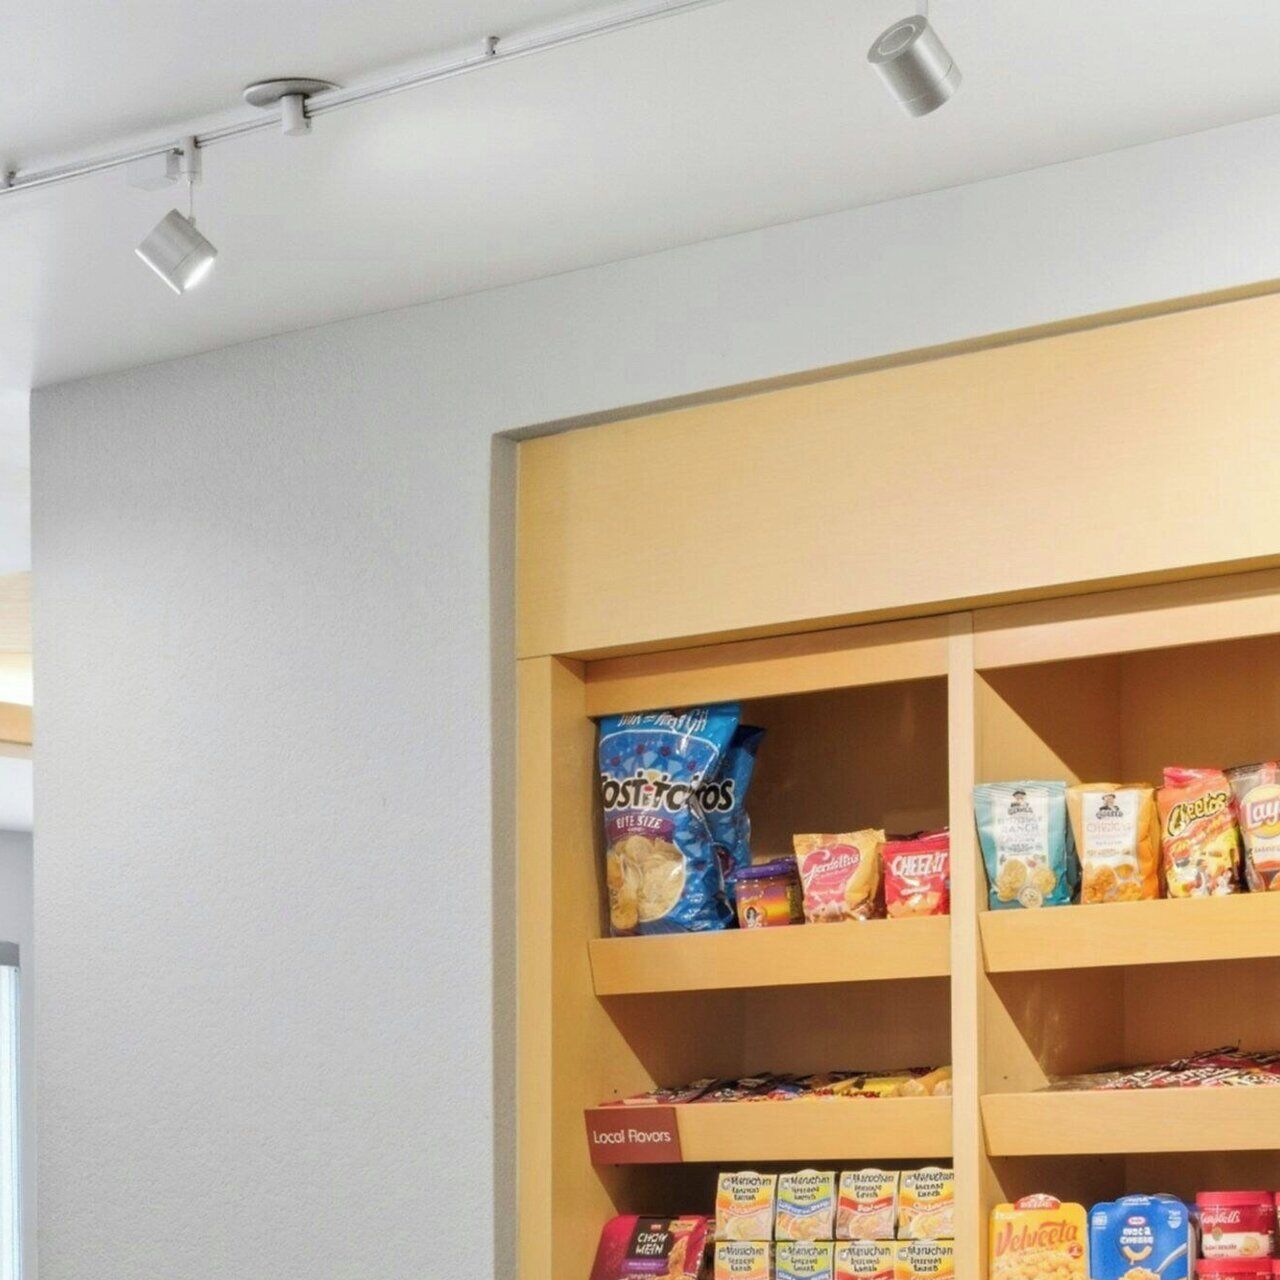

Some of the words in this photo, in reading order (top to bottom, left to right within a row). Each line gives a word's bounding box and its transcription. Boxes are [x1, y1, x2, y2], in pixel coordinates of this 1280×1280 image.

[593, 1129, 625, 1144] Local
[627, 1128, 672, 1143] Flavors
[637, 1232, 669, 1243] CHOW
[995, 1219, 1078, 1257] Velveeta
